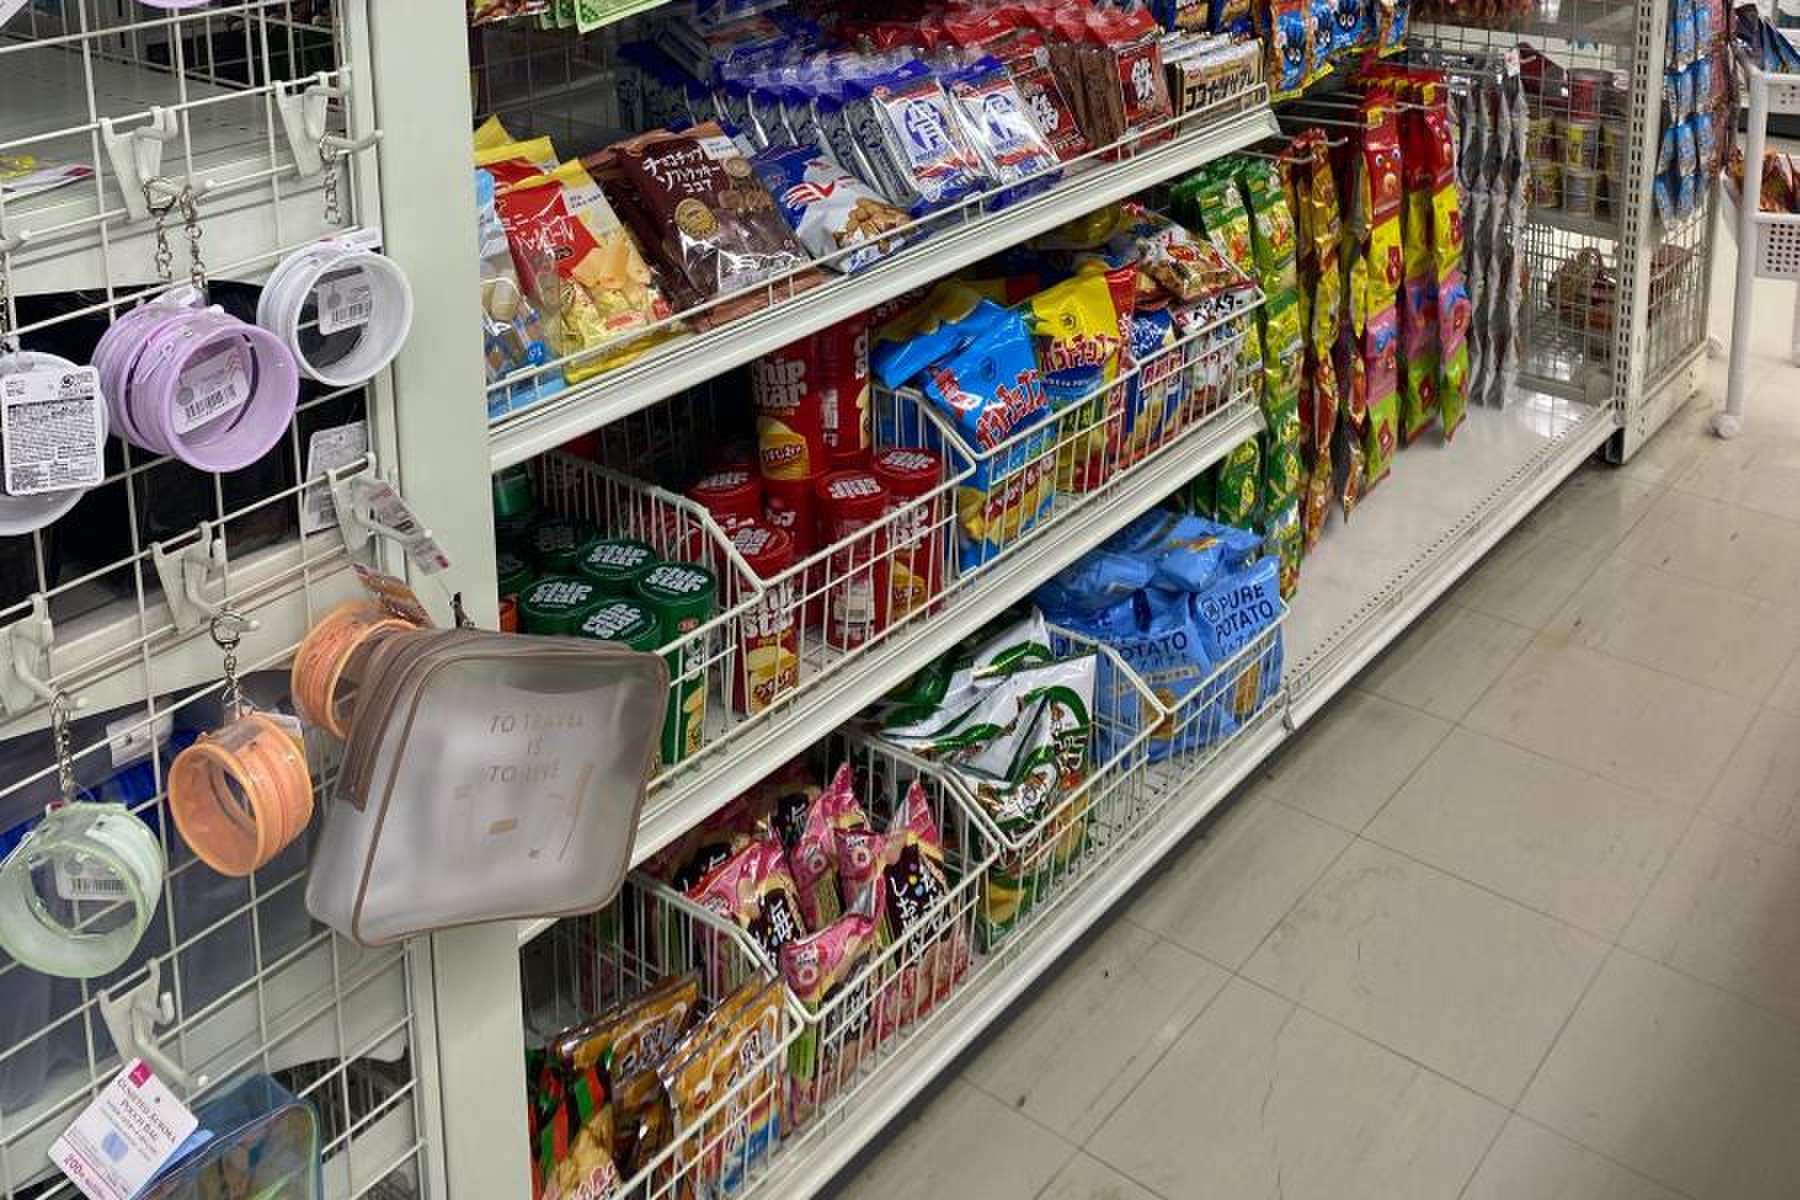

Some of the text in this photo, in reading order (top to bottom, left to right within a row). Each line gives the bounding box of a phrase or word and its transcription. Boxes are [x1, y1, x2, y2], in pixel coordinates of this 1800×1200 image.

[586, 552, 644, 567] star
[590, 544, 649, 558] chip
[654, 565, 709, 584] chip
[529, 590, 588, 605] star
[535, 581, 593, 596] chip
[1219, 583, 1266, 612] PURE
[1215, 599, 1274, 644] POTATO
[489, 714, 515, 733] TO
[489, 764, 515, 784] TO
